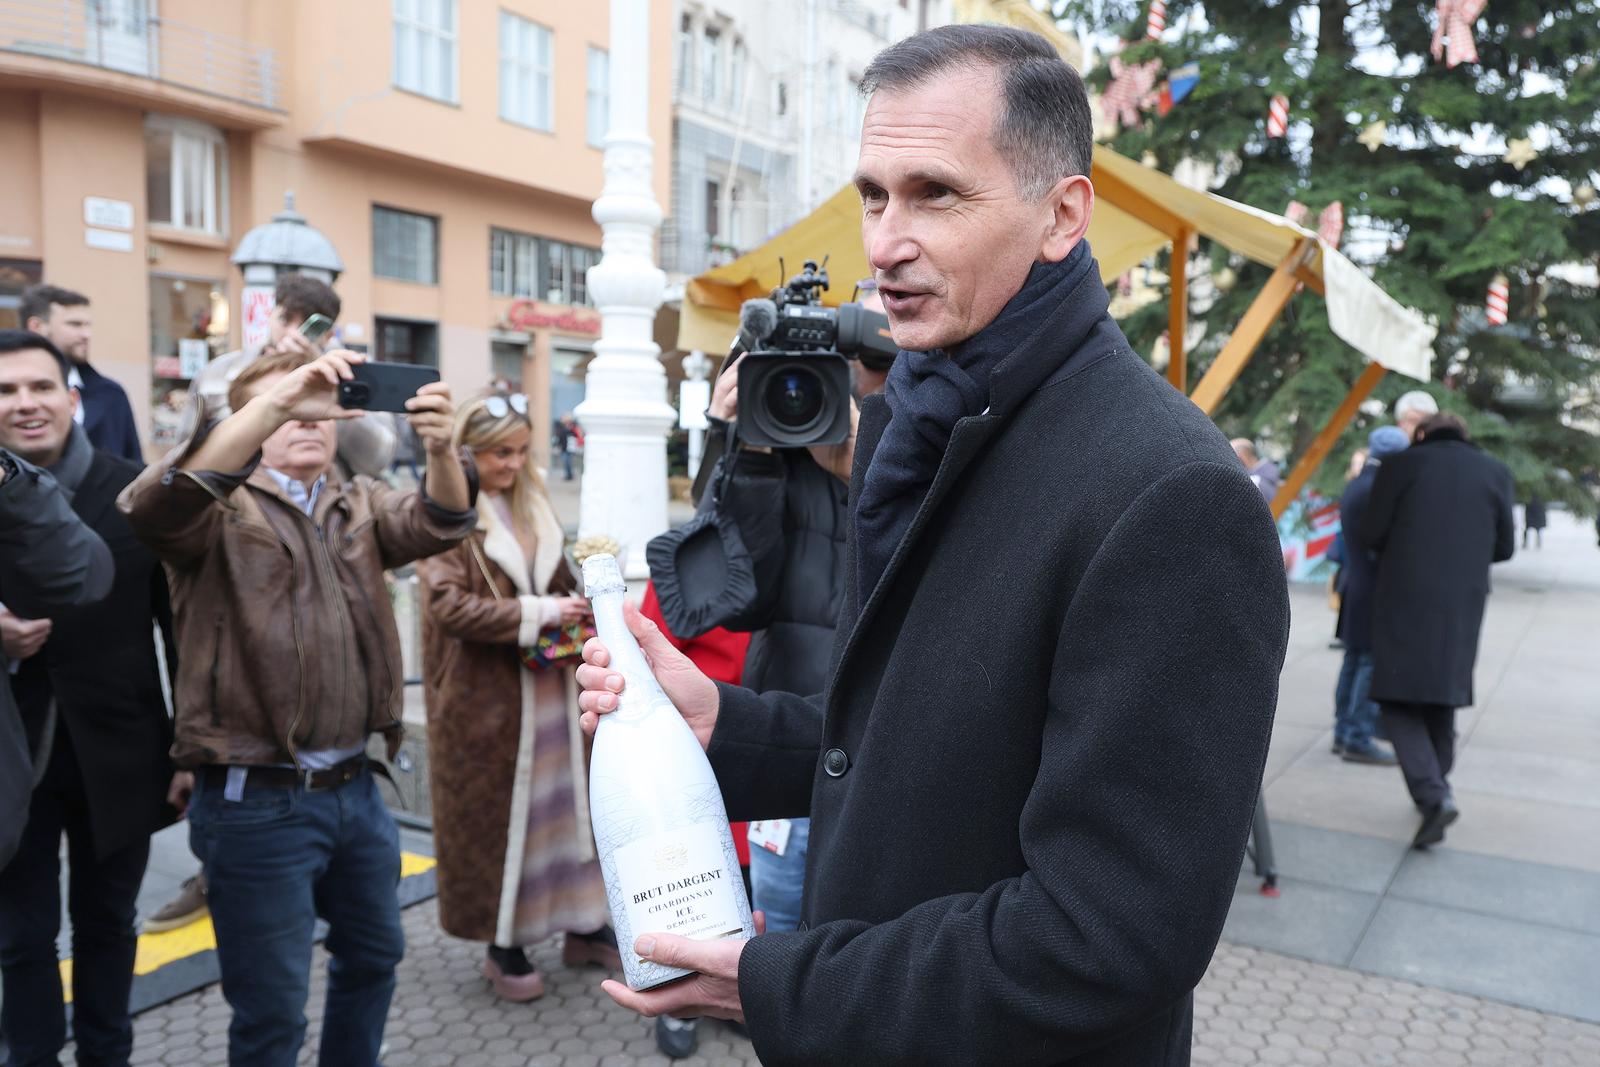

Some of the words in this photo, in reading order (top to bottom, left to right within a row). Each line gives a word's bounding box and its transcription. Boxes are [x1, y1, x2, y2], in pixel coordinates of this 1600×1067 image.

[633, 886, 663, 904] BRUT
[667, 869, 722, 893] DARGENT
[648, 888, 713, 914] CHARDONNAY
[666, 913, 707, 930] DEMI-SEC
[676, 906, 693, 918] ICE
